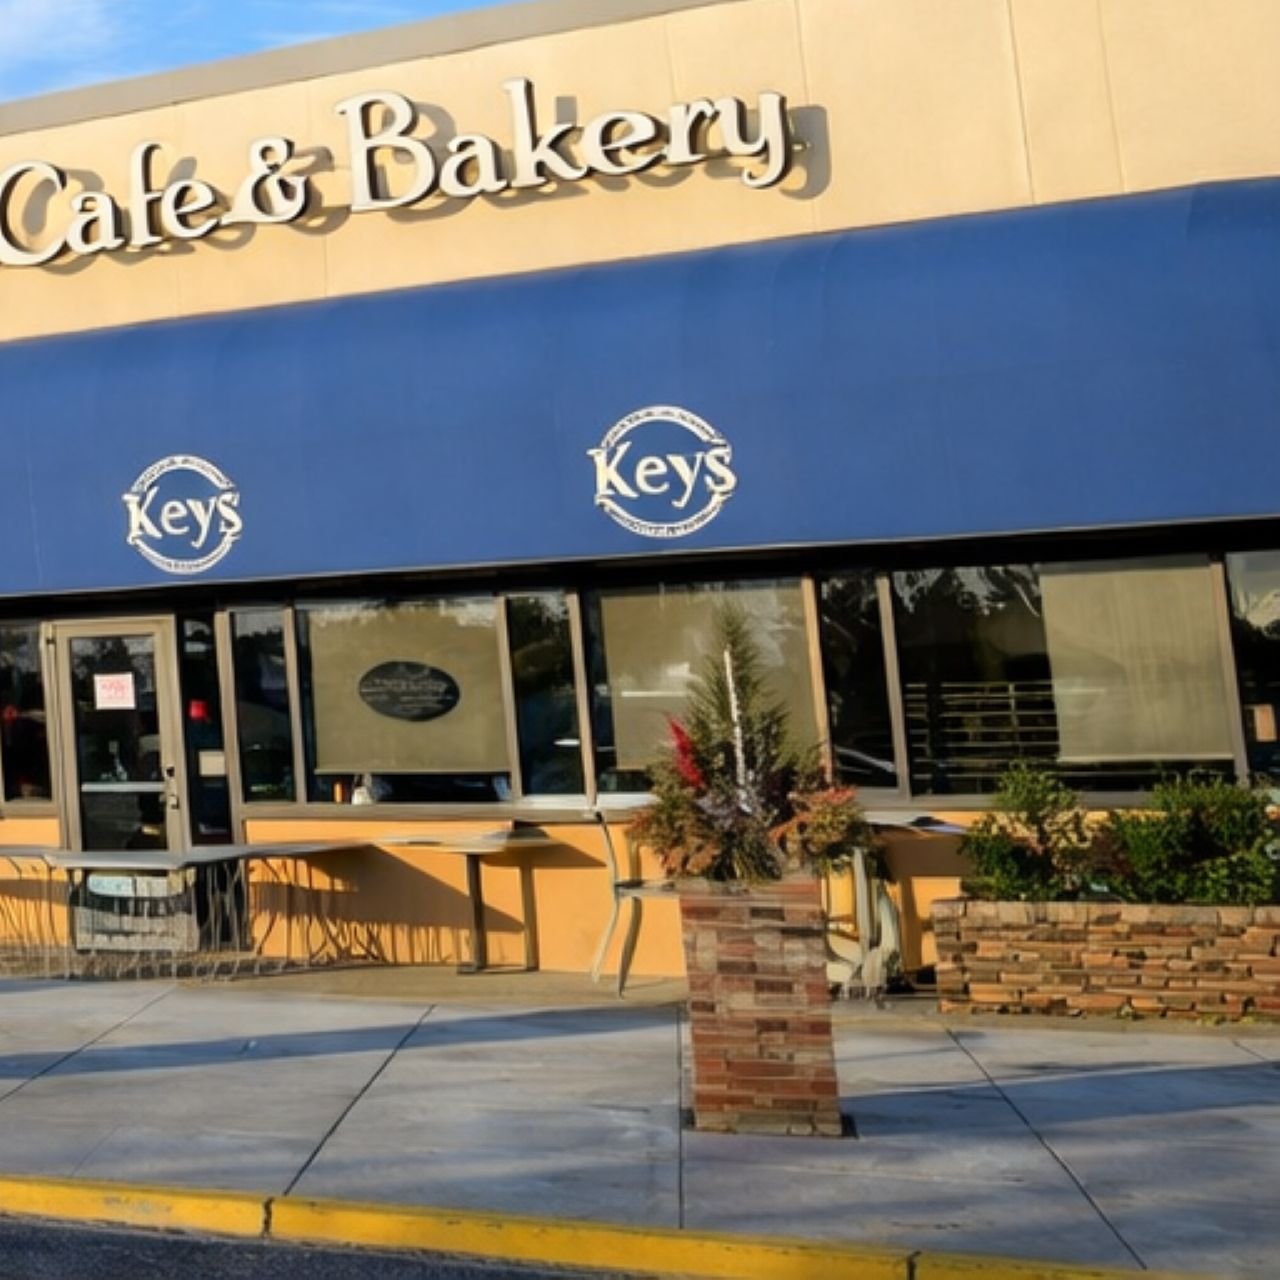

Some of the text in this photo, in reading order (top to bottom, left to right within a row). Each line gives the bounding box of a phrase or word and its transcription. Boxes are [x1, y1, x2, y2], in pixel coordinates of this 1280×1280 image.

[221, 138, 308, 225] &
[335, 77, 791, 212] Bakery
[586, 441, 737, 508] Keys
[122, 486, 243, 549] Keys
